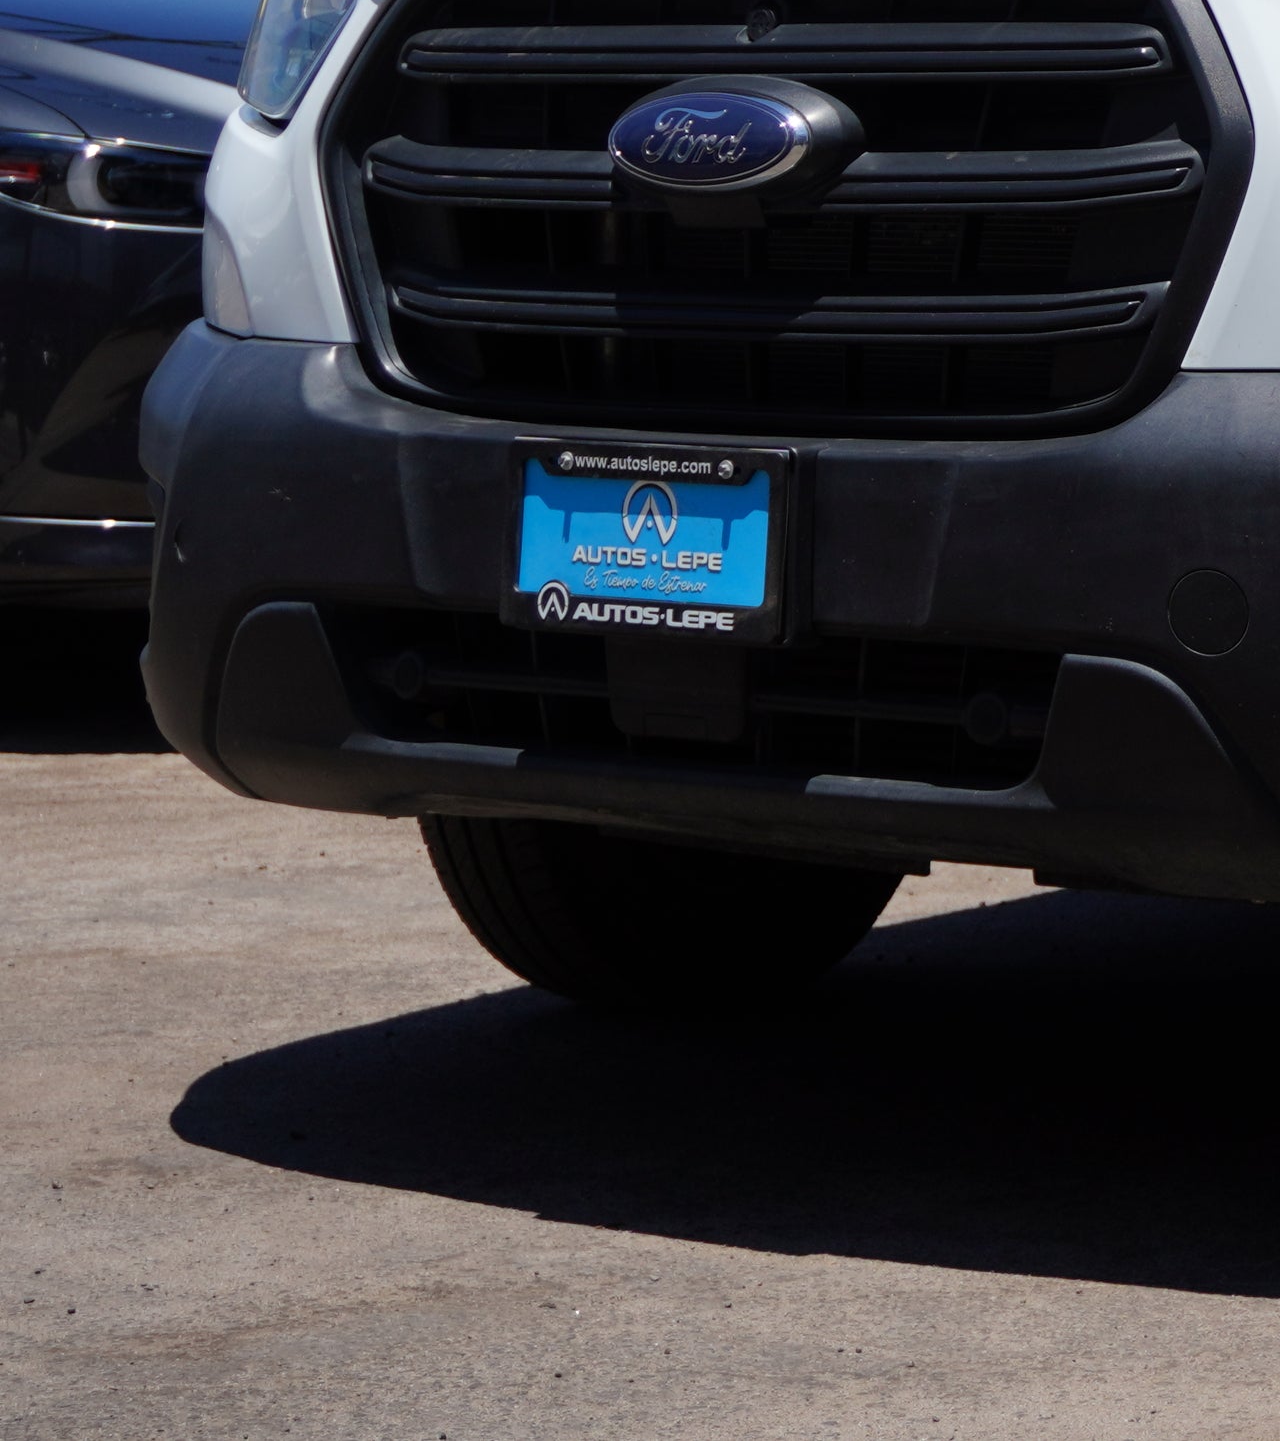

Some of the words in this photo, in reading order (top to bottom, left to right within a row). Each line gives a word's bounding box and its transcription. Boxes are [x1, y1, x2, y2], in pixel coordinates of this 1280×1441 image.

[640, 106, 753, 165] Ford
[574, 455, 712, 476] www.autoslepe.com
[572, 544, 647, 567] AUTOS
[661, 549, 723, 571] LEPE
[583, 565, 599, 590] Es
[602, 569, 639, 591] Tiempo
[641, 573, 657, 590] de
[657, 570, 708, 594] Estrenar
